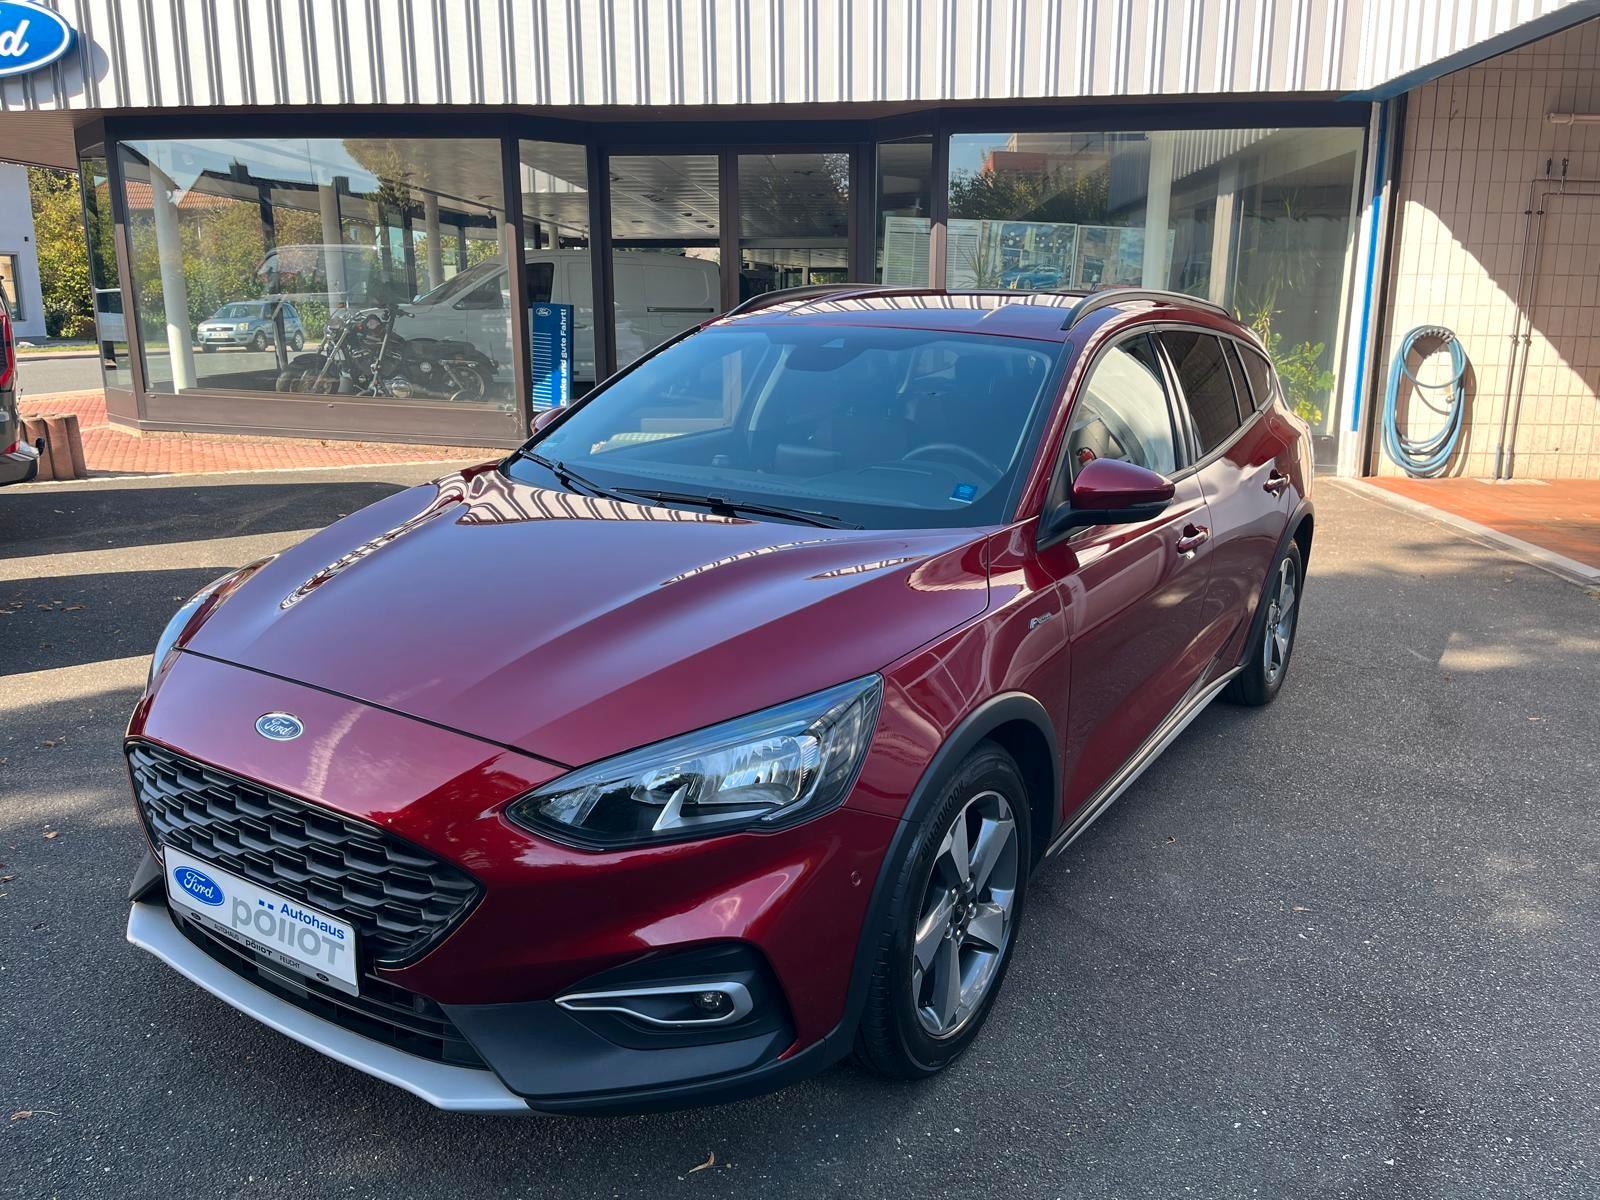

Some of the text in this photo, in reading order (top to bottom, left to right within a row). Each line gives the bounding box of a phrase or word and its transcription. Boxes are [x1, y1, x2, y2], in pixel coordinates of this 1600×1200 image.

[560, 337, 568, 358] gute
[264, 717, 293, 736] Ford
[183, 871, 214, 898] Ford
[280, 903, 345, 940] Autohaus
[214, 923, 240, 941] AUTOHAUS
[279, 955, 301, 969] FEUCHT
